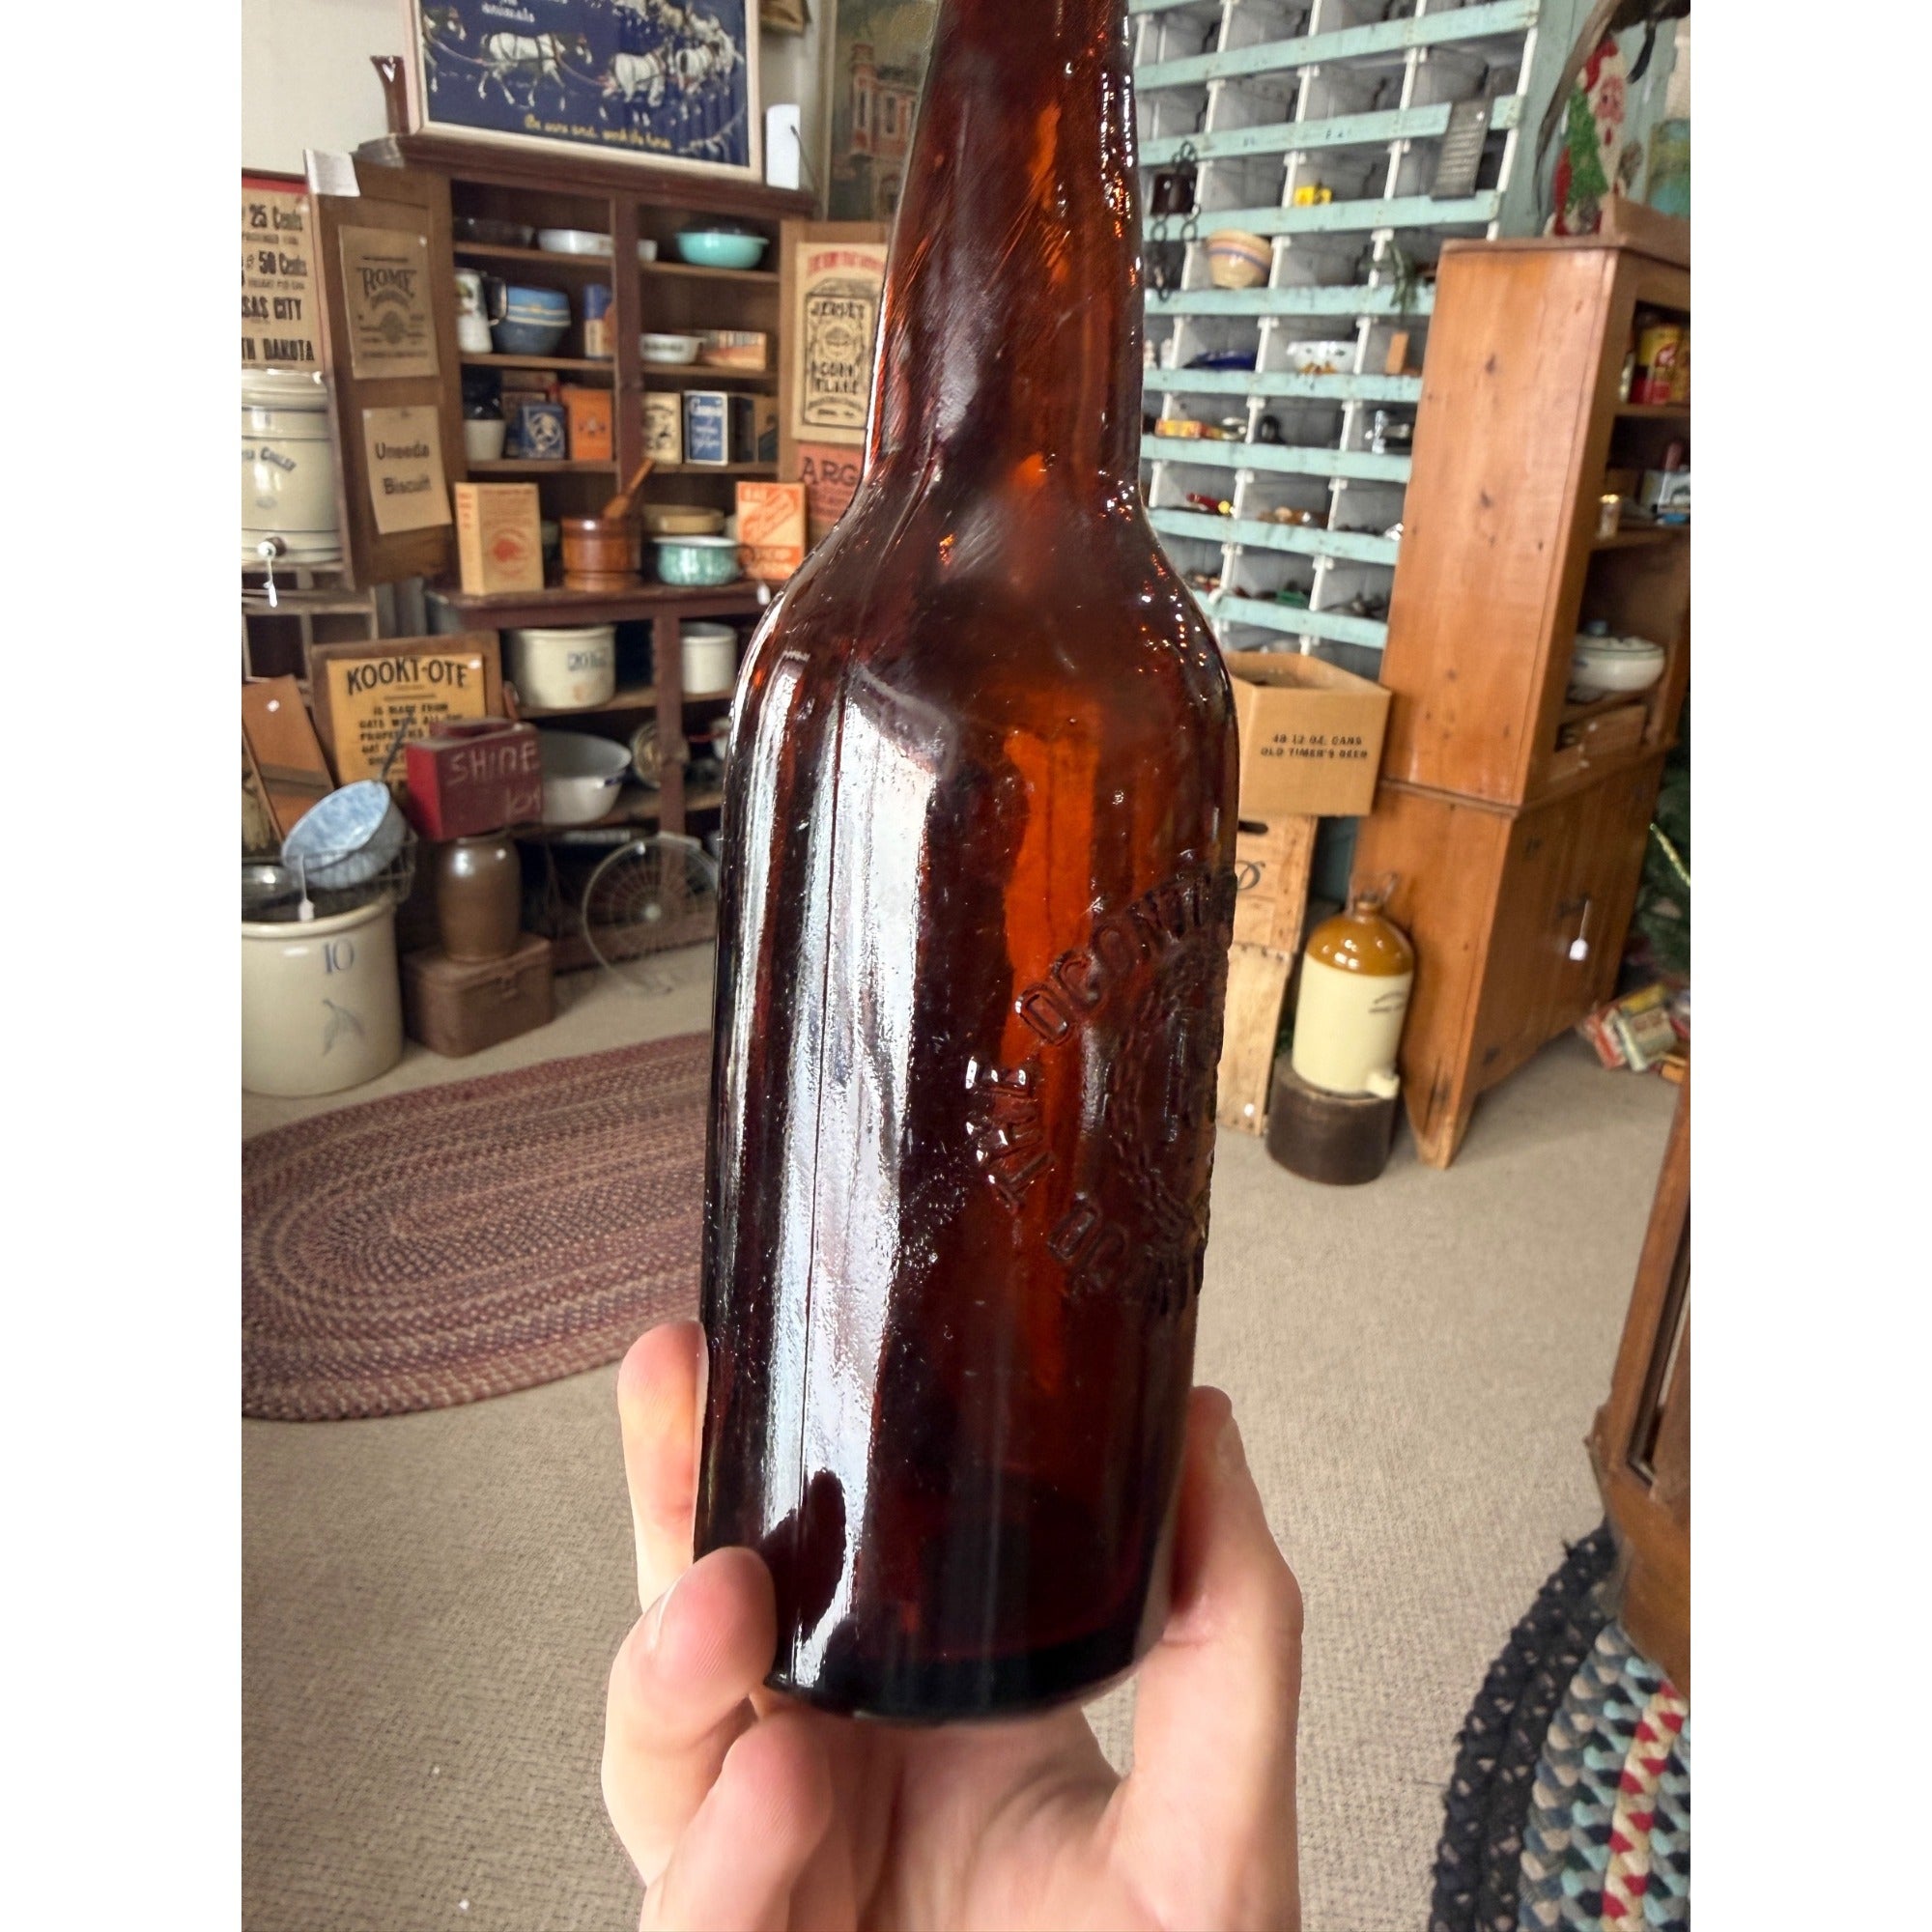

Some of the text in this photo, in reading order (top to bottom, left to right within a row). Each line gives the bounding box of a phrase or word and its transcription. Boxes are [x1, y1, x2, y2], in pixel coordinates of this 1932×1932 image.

[273, 297, 301, 321] CITY
[797, 456, 859, 488] ARG
[323, 939, 355, 974] 10
